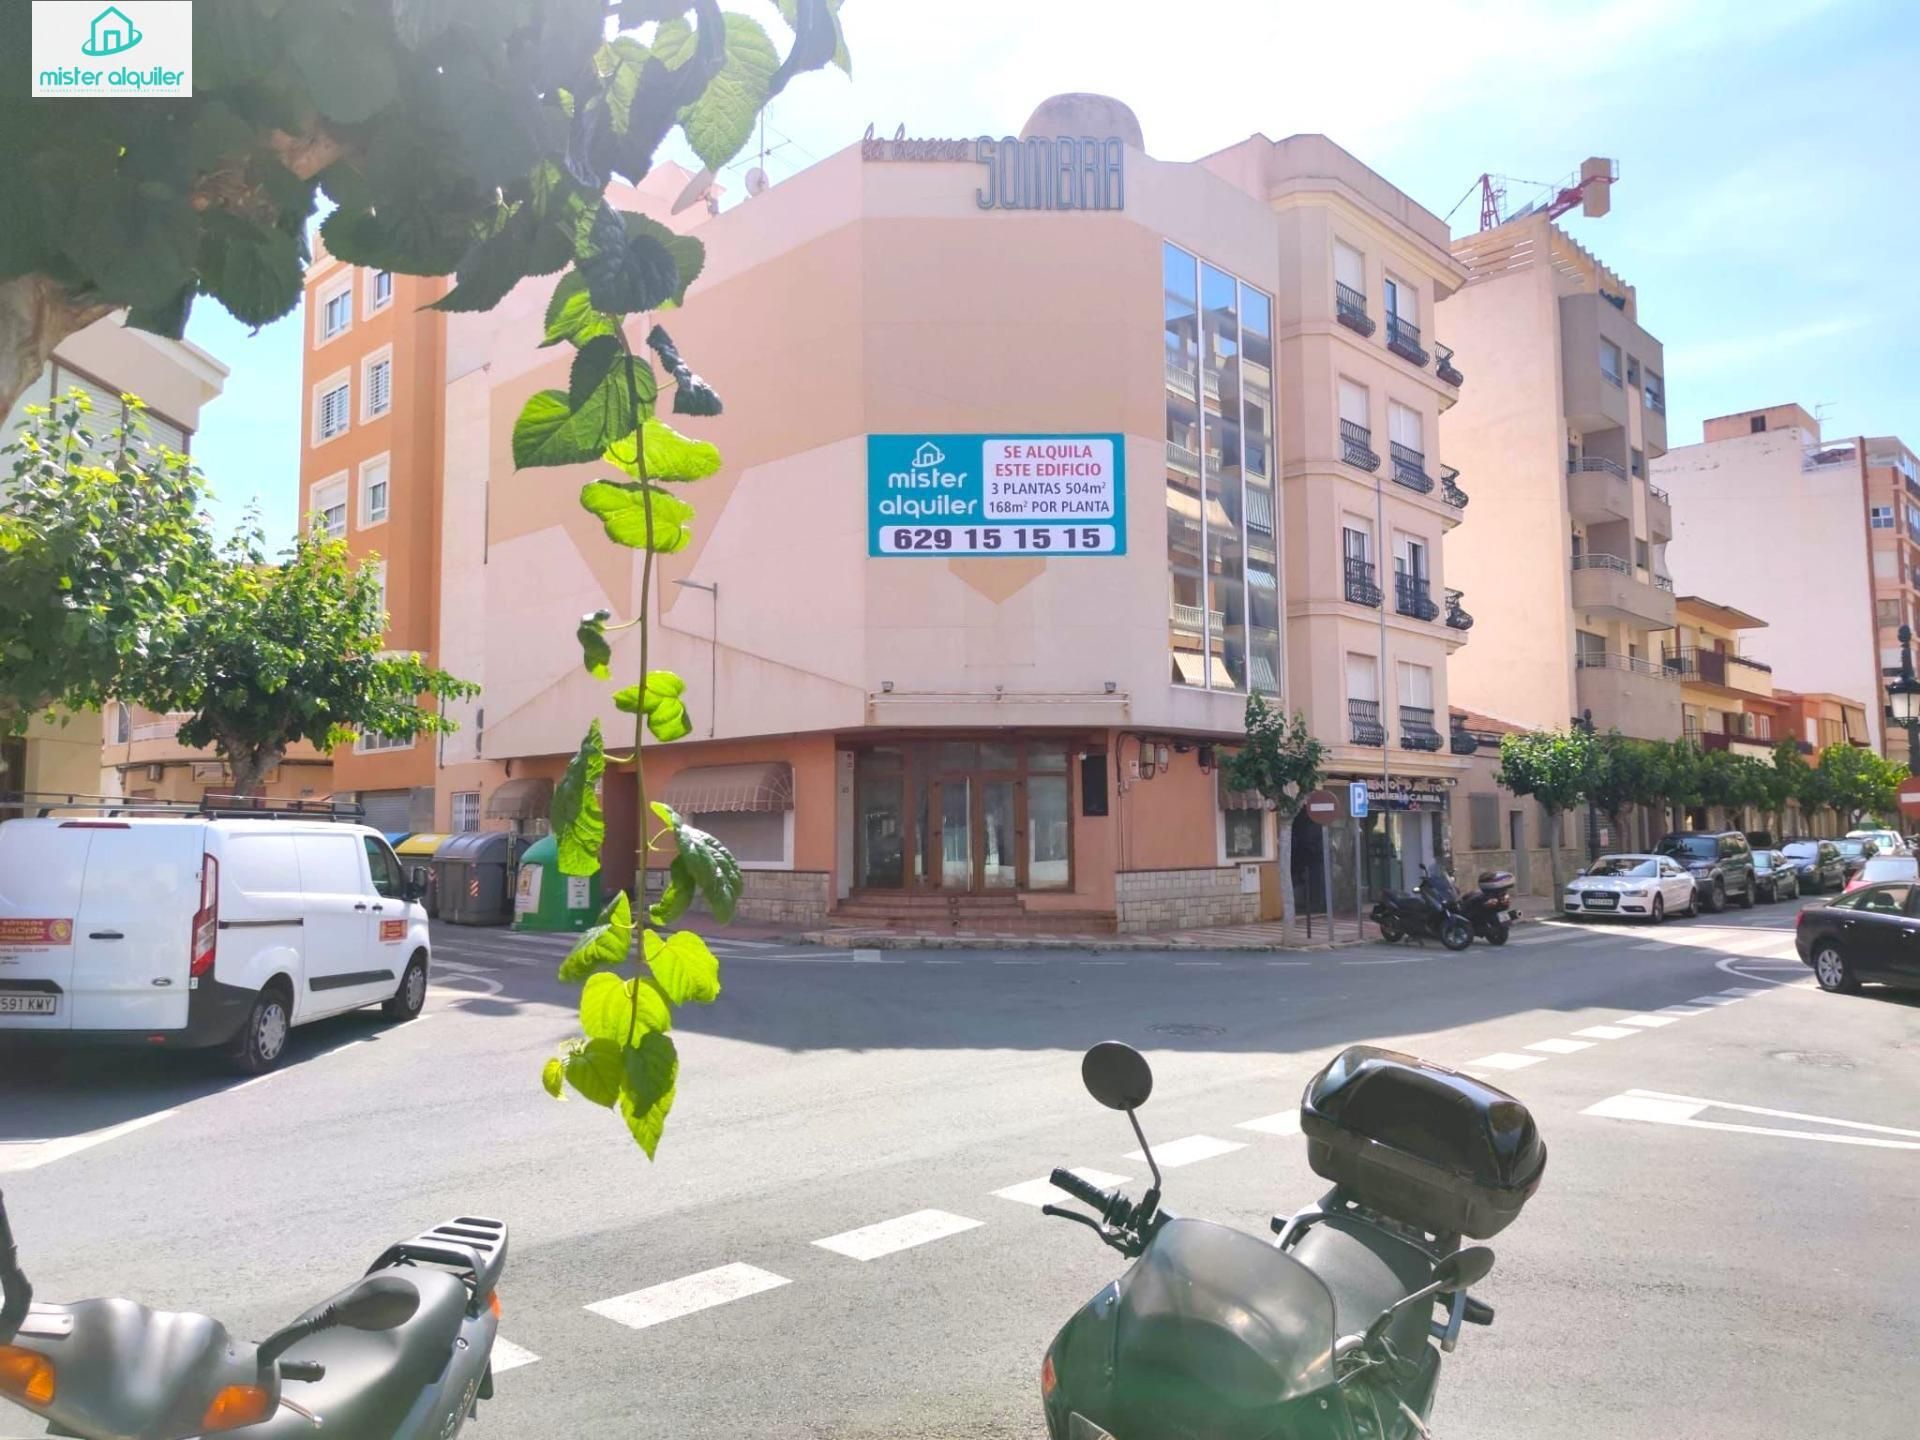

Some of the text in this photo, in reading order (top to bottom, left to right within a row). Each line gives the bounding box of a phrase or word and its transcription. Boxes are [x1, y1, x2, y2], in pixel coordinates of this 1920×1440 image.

[976, 135, 1124, 210] SOMBRA
[1004, 445, 1093, 460] SE ALQUILA
[888, 468, 967, 488] mister
[995, 463, 1101, 477] ESTE EDIFICIO
[991, 482, 999, 495] 3
[1003, 482, 1061, 495] PLANTAS
[879, 495, 978, 519] alquiler
[1032, 501, 1057, 512] POR
[1061, 501, 1110, 512] PLANTA
[894, 528, 1101, 550] 629 15 15 15
[1354, 786, 1365, 813] P
